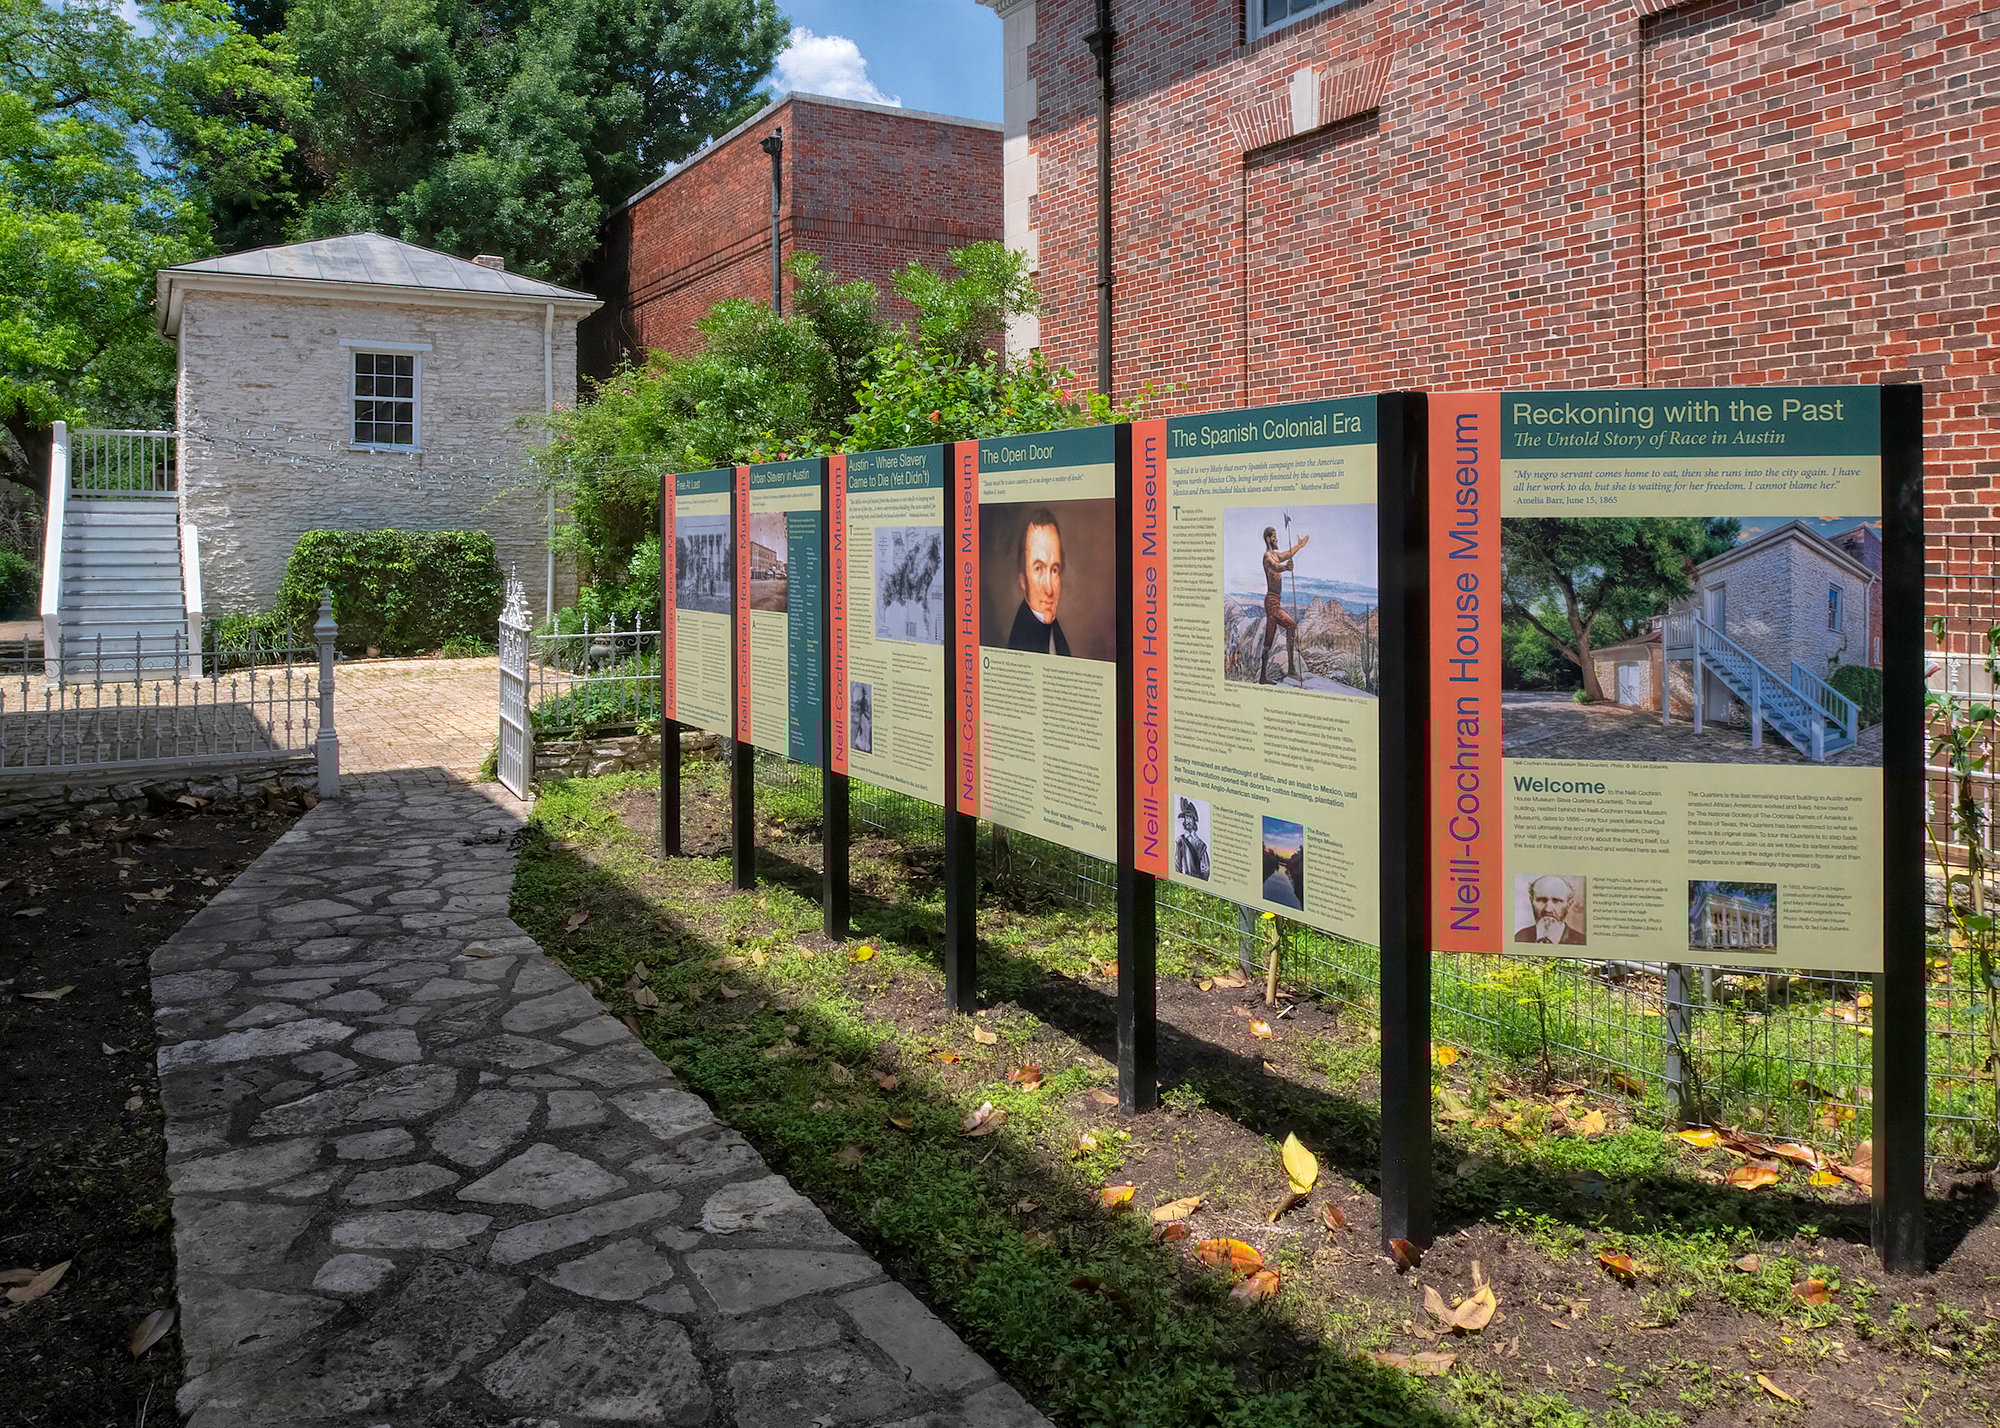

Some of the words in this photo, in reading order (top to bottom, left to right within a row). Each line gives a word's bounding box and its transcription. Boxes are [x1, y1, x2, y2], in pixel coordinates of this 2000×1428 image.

[1171, 429, 1197, 448] The
[1200, 421, 1258, 448] Spanish
[1262, 414, 1327, 440] Colonial
[1333, 412, 1361, 434] Era
[1513, 401, 1654, 428] Reckoning
[1663, 400, 1719, 423] with
[1728, 399, 1772, 422] the
[1782, 398, 1844, 421] Past
[981, 449, 999, 464] The
[1000, 447, 1027, 465] Open
[1029, 445, 1054, 460] Door
[1513, 431, 1542, 447] The
[1547, 430, 1600, 446] Untold
[1603, 431, 1645, 450] Story
[1649, 430, 1668, 449] of
[1668, 430, 1707, 445] Race
[1711, 430, 1727, 444] in
[1731, 430, 1785, 444] Austin
[751, 472, 766, 484] Urban
[766, 471, 786, 484] Slavery
[786, 469, 791, 481] in
[792, 467, 810, 480] Austin
[848, 458, 869, 472] Austin
[875, 455, 898, 469] Where
[899, 454, 926, 468] Slavery
[848, 475, 868, 489] Came
[868, 475, 876, 487] to
[877, 473, 889, 487] Die
[890, 472, 904, 489] (Yet
[1172, 478, 1188, 488] regions
[1188, 476, 1202, 485] north
[1207, 475, 1225, 484] Mexico
[1237, 474, 1252, 484] being
[1251, 472, 1269, 484] largely
[1268, 471, 1292, 483] financed
[1300, 470, 1310, 479] the
[1309, 470, 1336, 481] conquests
[1199, 467, 1210, 475] very
[1210, 464, 1223, 474] likely
[1223, 463, 1234, 472] that
[1233, 464, 1248, 473] every
[1247, 461, 1268, 473] Spanish
[1268, 460, 1294, 471] campaign
[1294, 459, 1306, 468] into
[1306, 459, 1316, 467] the
[1316, 457, 1345, 468] American
[1533, 472, 1558, 481] negro
[1560, 470, 1593, 479] servant
[1623, 468, 1650, 478] home
[1681, 468, 1702, 477] then
[1703, 468, 1719, 477] she
[1744, 468, 1763, 477] into
[1765, 467, 1780, 477] the
[1781, 468, 1799, 479] city
[1798, 467, 1829, 480] again.
[1831, 467, 1837, 476] I
[1838, 466, 1861, 476] have
[676, 479, 686, 490] Free
[691, 479, 700, 490] Last
[1142, 438, 1158, 555] Museum
[1188, 487, 1199, 495] and
[1211, 485, 1233, 494] included
[1232, 485, 1246, 494] black
[1246, 484, 1262, 493] slaves
[1261, 484, 1273, 492] and
[1322, 481, 1340, 490] Restall
[1449, 414, 1479, 559] Museum
[1512, 482, 1525, 491] all
[1526, 482, 1541, 491] her
[1543, 482, 1566, 492] work
[1567, 483, 1577, 491] to
[1578, 482, 1592, 491] do,
[1594, 481, 1610, 491] but
[1611, 481, 1627, 491] she
[1628, 482, 1636, 491] is
[1638, 482, 1672, 493] waiting
[1671, 480, 1687, 493] for
[1688, 480, 1705, 490] her
[1704, 480, 1746, 493] freedom.
[1748, 481, 1753, 490] I
[1755, 482, 1787, 490] cannot
[1788, 480, 1818, 490] blame
[1545, 496, 1565, 504] Barr,
[1566, 496, 1584, 505] June
[1586, 496, 1598, 504] 15,
[1599, 496, 1618, 504] 1865
[833, 467, 843, 550] Museum
[962, 456, 972, 552] Museum
[834, 559, 843, 620] House
[963, 562, 973, 634] House
[1143, 567, 1158, 655] House
[1449, 573, 1480, 682] House
[740, 616, 748, 732] Neill-Cochran
[834, 629, 844, 761] Neill-Cochran
[962, 645, 973, 800] Neill-Cochran
[1143, 668, 1158, 857] Neill-Cochran
[1173, 755, 1191, 768] Slavery
[1191, 759, 1214, 773] remained
[1221, 765, 1252, 778] afterthought
[1259, 772, 1276, 783] Spain,
[1276, 777, 1288, 785] and
[1296, 779, 1312, 790] insult
[1320, 784, 1343, 797] Mexico,
[1343, 791, 1358, 799] until
[1174, 776, 1200, 787] agriculture,
[1210, 783, 1250, 798] Anglo-American
[1250, 792, 1271, 804] slavery.
[1182, 767, 1196, 779] Texas
[1196, 770, 1220, 781] revolution
[1220, 776, 1240, 786] opened
[1239, 779, 1249, 787] the
[1249, 781, 1265, 791] doors
[1271, 787, 1290, 796] cotton
[1290, 790, 1314, 803] farming,
[1314, 795, 1344, 808] plantation
[1513, 776, 1606, 794] Welcome
[1449, 697, 1480, 930] Neill-Cochran
